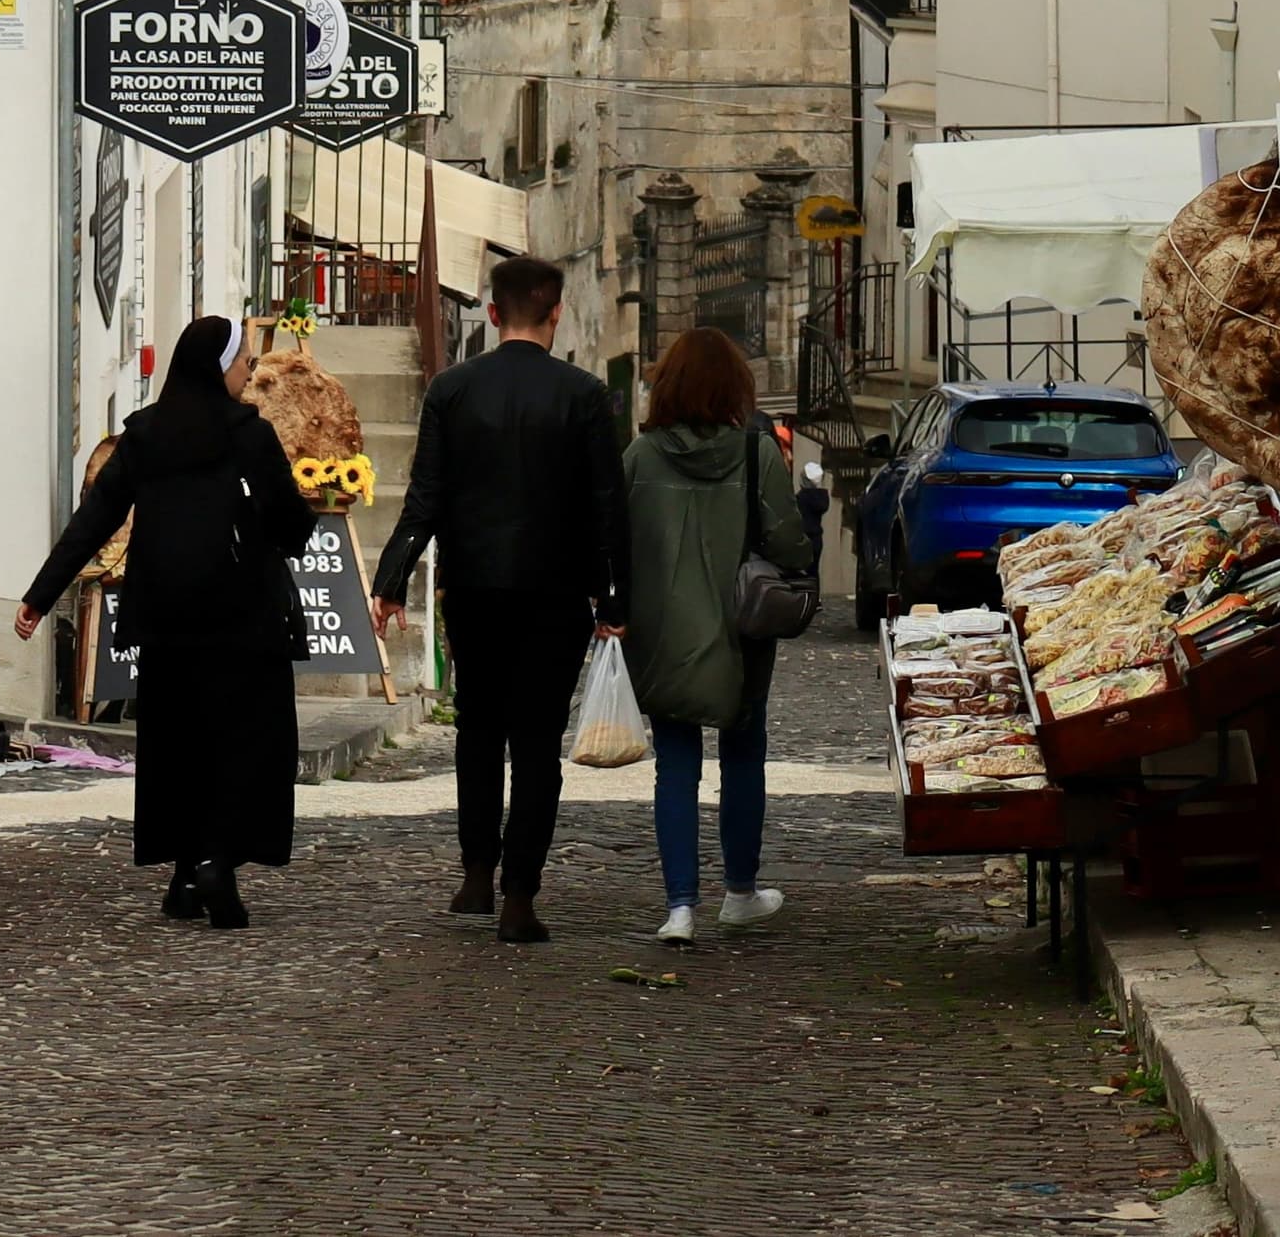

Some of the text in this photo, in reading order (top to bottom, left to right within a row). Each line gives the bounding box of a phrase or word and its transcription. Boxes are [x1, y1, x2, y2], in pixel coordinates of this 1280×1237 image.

[110, 12, 264, 44] FORNO
[110, 50, 264, 64] LA CASA DEL PANE
[361, 57, 396, 70] DEL
[111, 76, 262, 90] PRODOTTI TIPICI
[111, 92, 264, 102] PANE CALDO COTTO A LEGNA
[120, 104, 172, 113] FOCACCIA
[181, 105, 211, 113] OSTIE
[214, 105, 255, 113] RIPIENE
[169, 116, 205, 125] PANINI
[290, 555, 343, 573] 1983
[299, 588, 331, 607] NE
[307, 635, 355, 654] GNA
